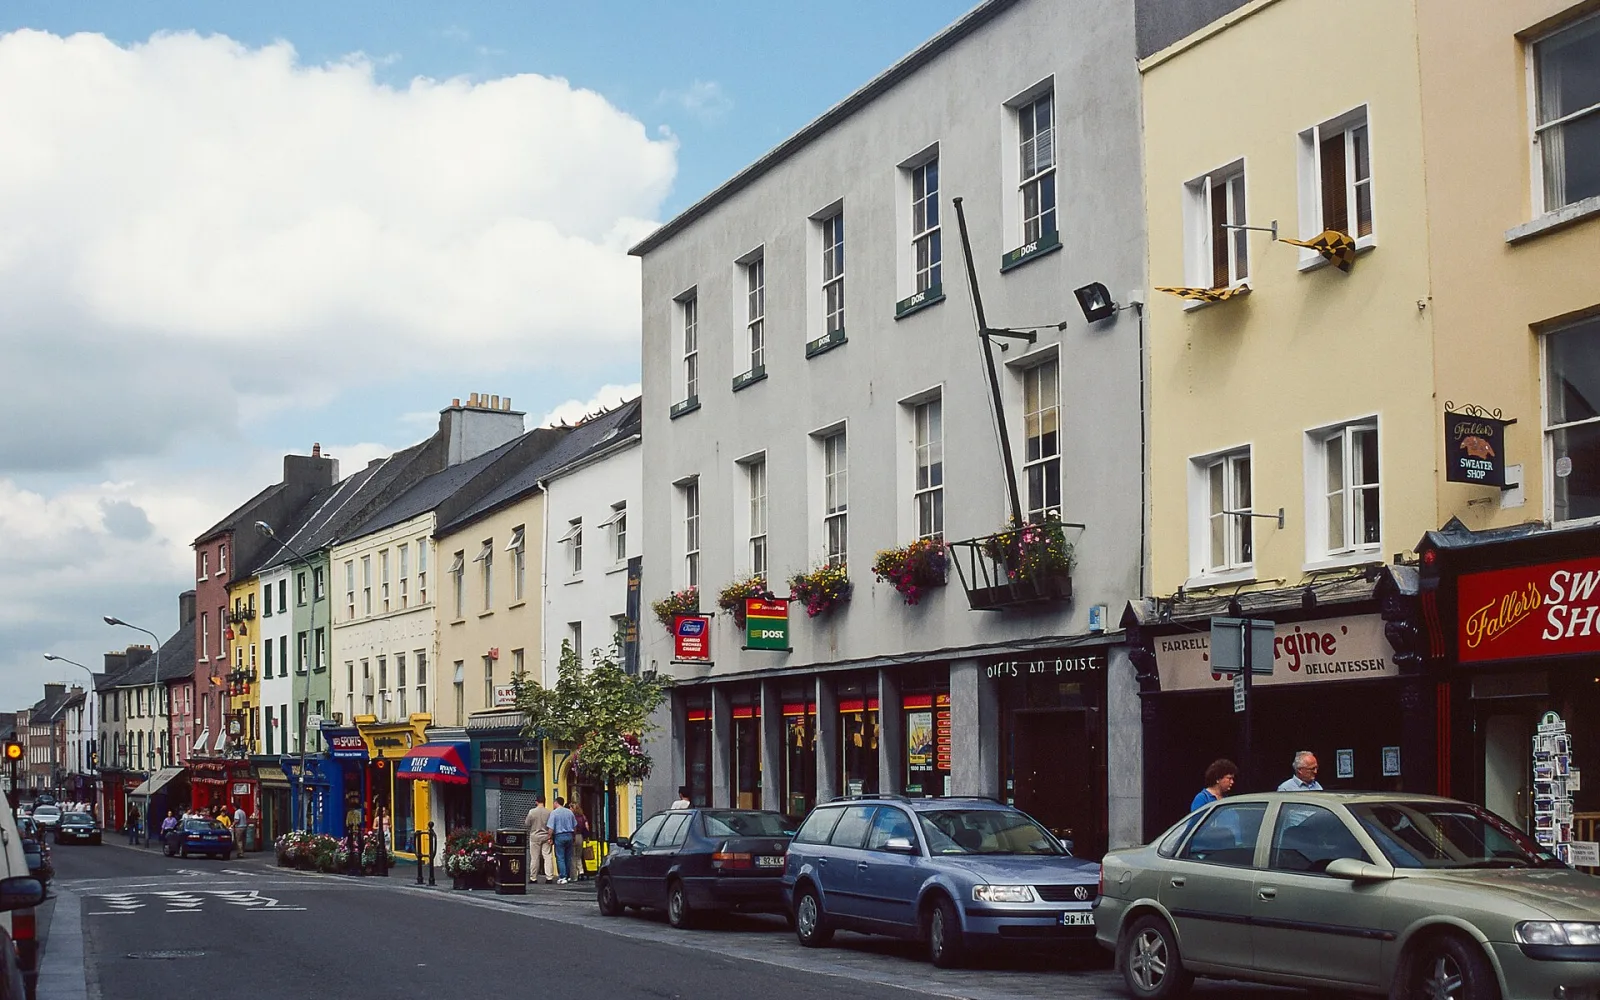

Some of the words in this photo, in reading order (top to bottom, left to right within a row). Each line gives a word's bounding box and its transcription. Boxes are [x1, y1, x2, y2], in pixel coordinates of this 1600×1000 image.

[1460, 458, 1494, 471] SWEATER
[1466, 469, 1486, 480] SHOP
[1466, 581, 1542, 648] Faller's
[1541, 604, 1600, 641] SH
[762, 630, 784, 639] post
[1305, 658, 1385, 675] DELICATESSEN
[340, 736, 362, 747] SPORTS
